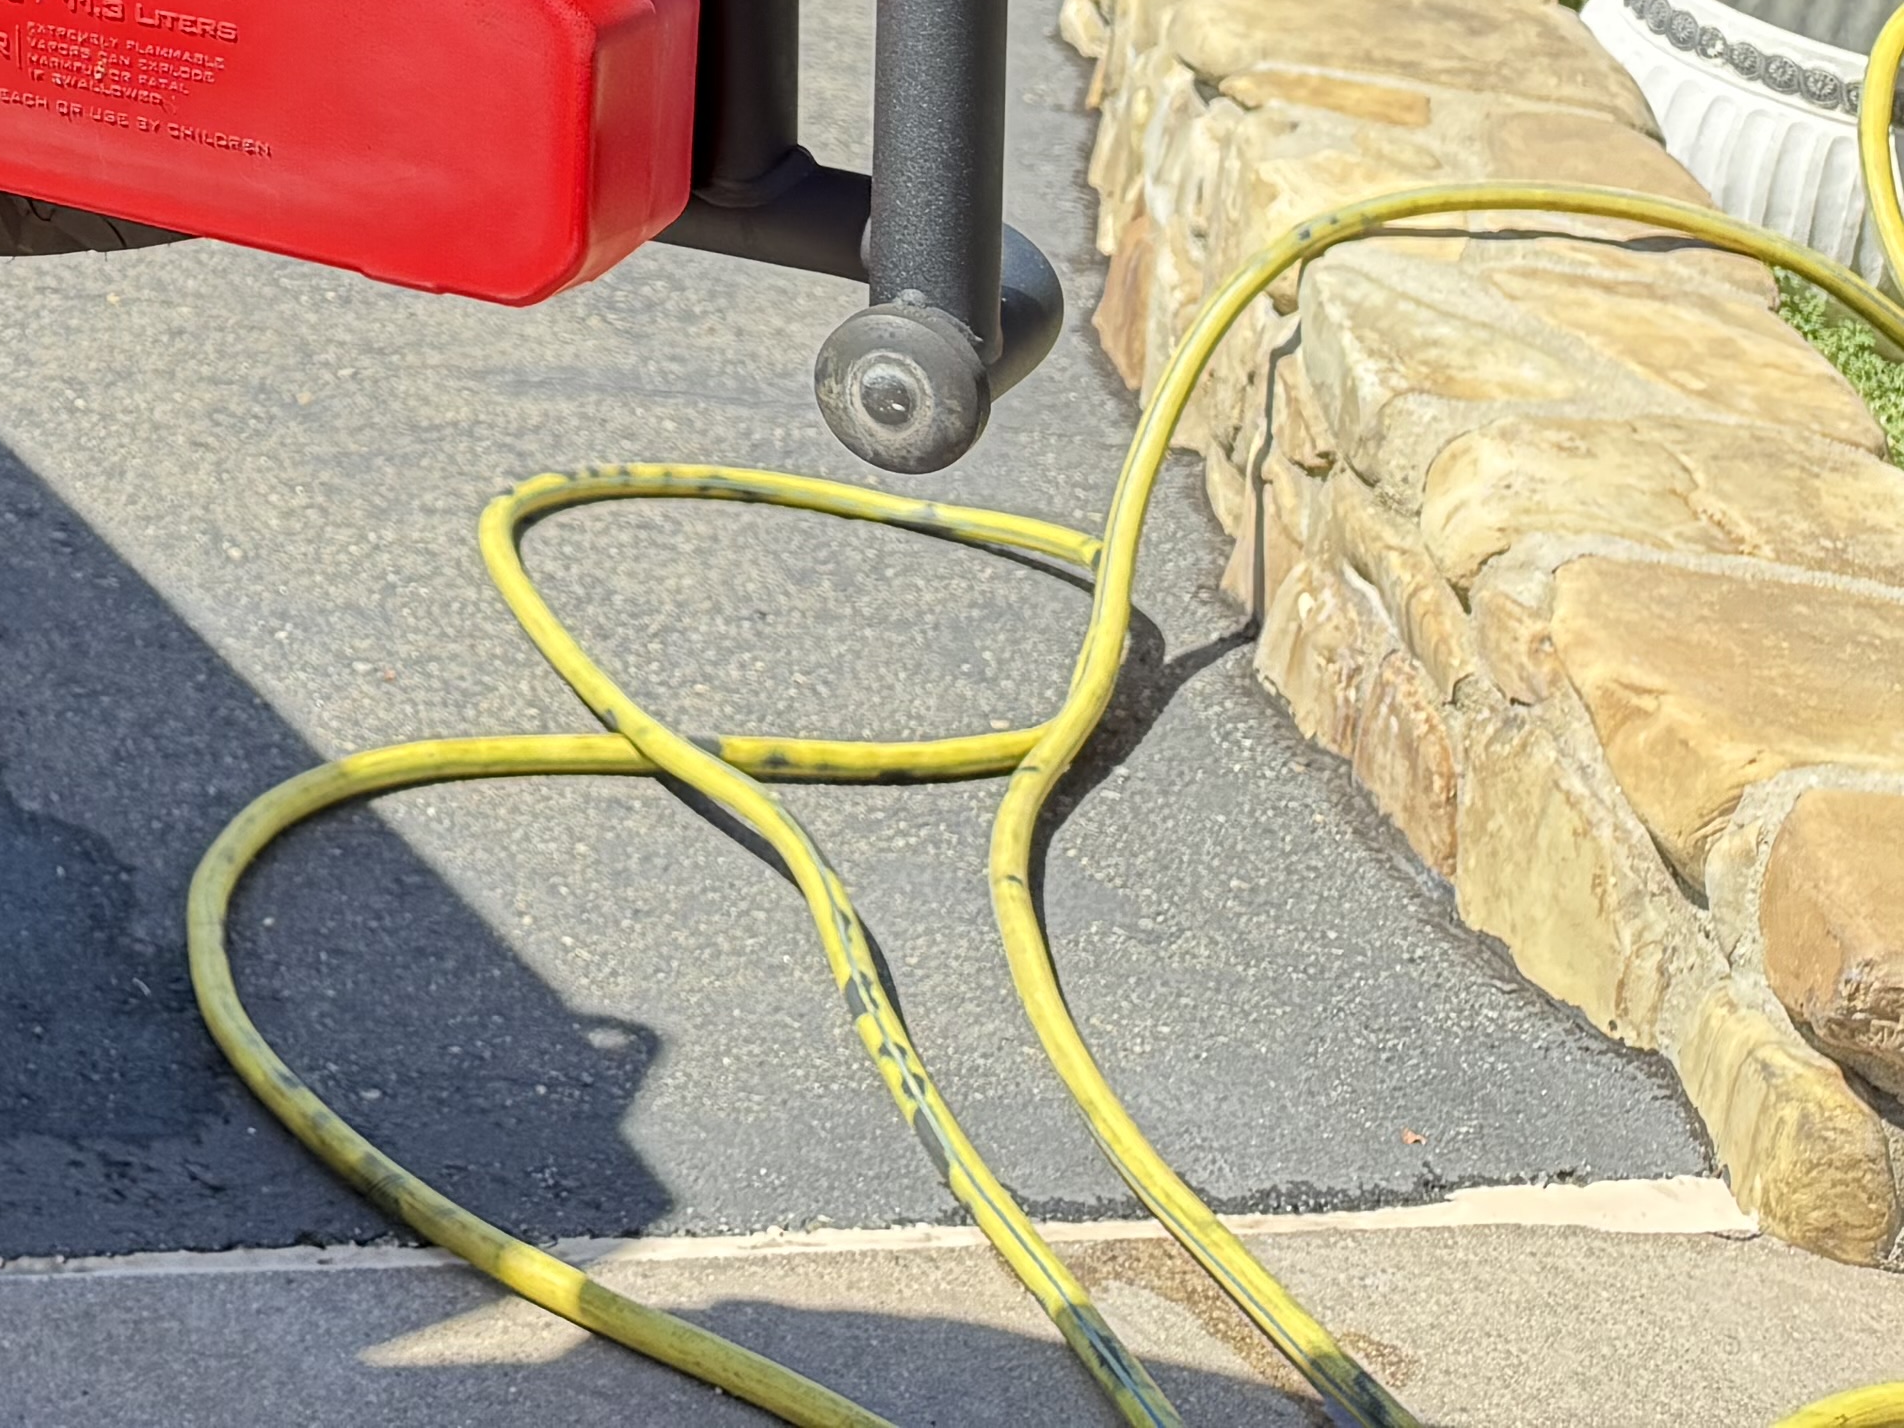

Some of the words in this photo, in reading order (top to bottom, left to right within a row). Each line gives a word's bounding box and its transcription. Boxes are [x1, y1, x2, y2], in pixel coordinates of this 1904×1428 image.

[135, 2, 238, 41] LITERS
[56, 99, 83, 119] OF
[90, 106, 130, 127] USE
[136, 116, 160, 132] BY
[167, 122, 272, 157] CHILDREN
